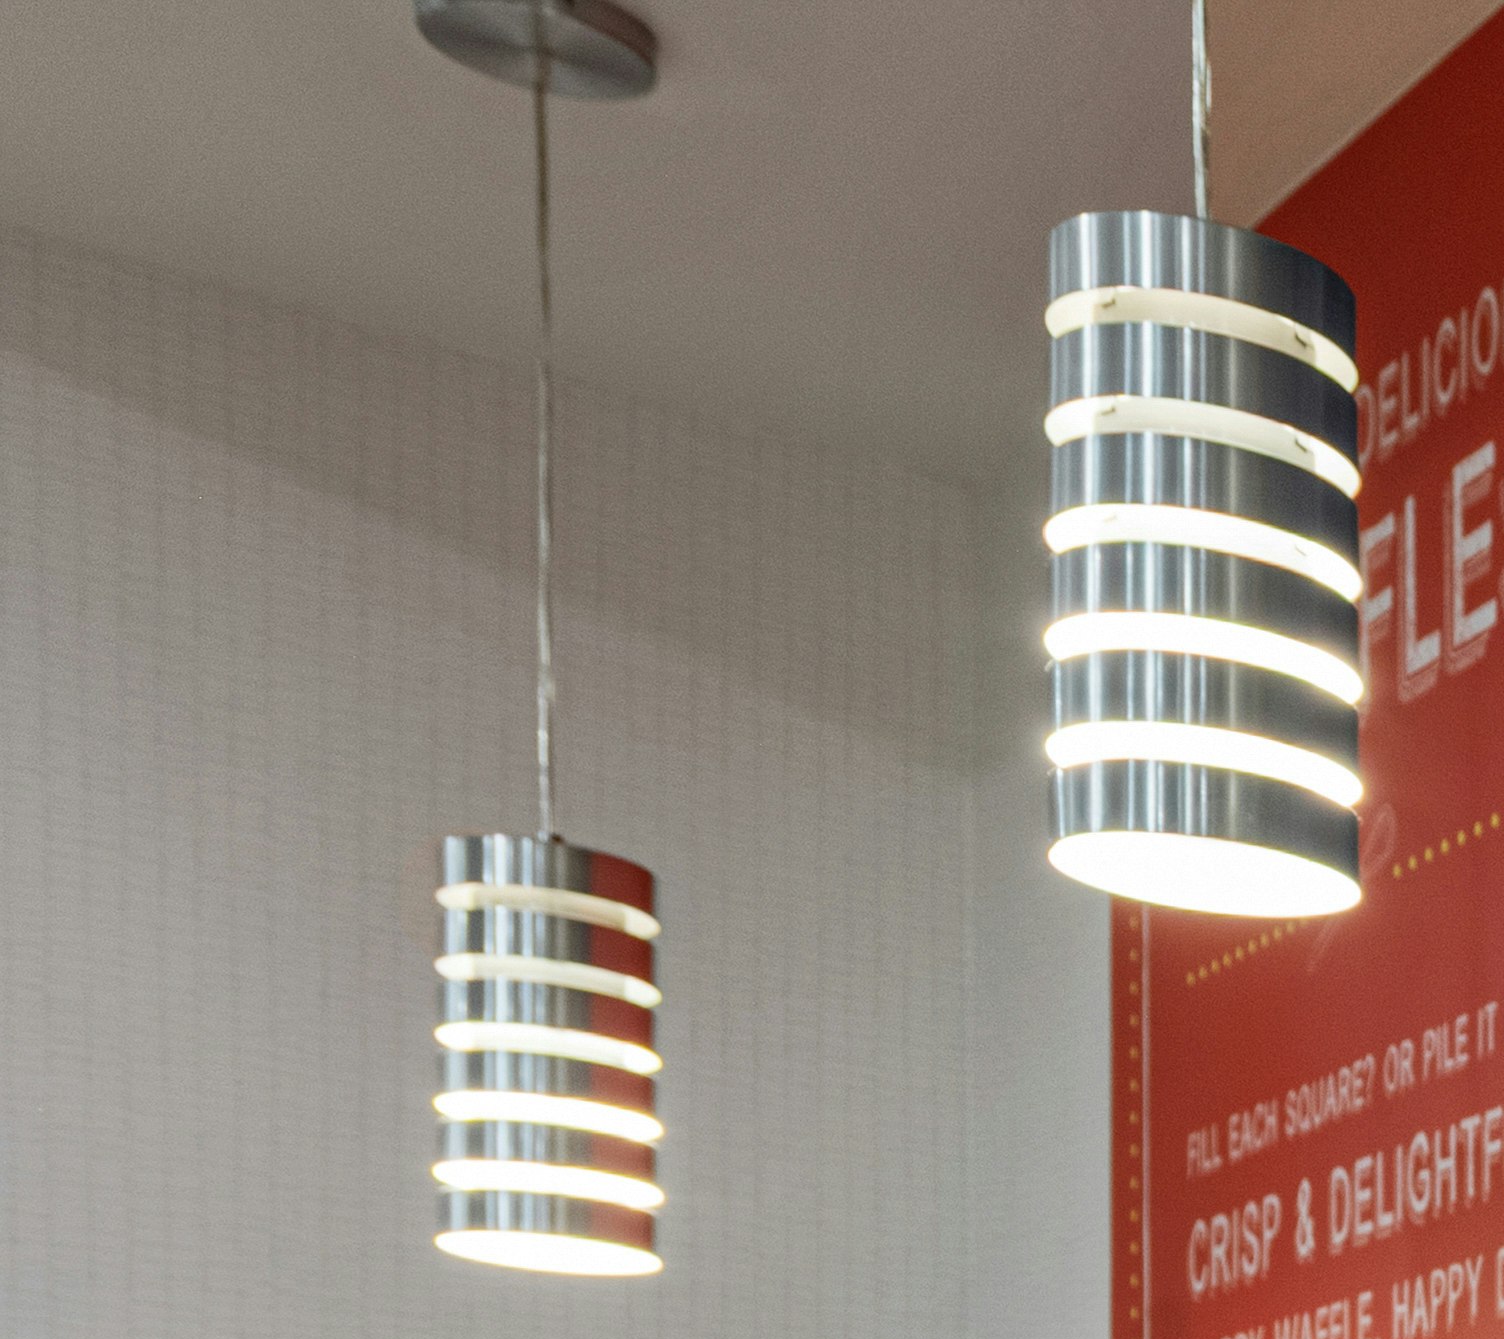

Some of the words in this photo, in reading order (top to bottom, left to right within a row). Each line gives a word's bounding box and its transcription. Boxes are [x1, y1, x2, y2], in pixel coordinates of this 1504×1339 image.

[1186, 1128, 1222, 1178] FILL
[1228, 1100, 1279, 1162] EACH
[1284, 1054, 1375, 1139] SQUARE?
[1383, 1039, 1415, 1097] OR
[1422, 1014, 1469, 1081] PILE
[1475, 1003, 1498, 1059] IT
[1187, 1194, 1282, 1298] CRISP
[1295, 1177, 1316, 1262] &
